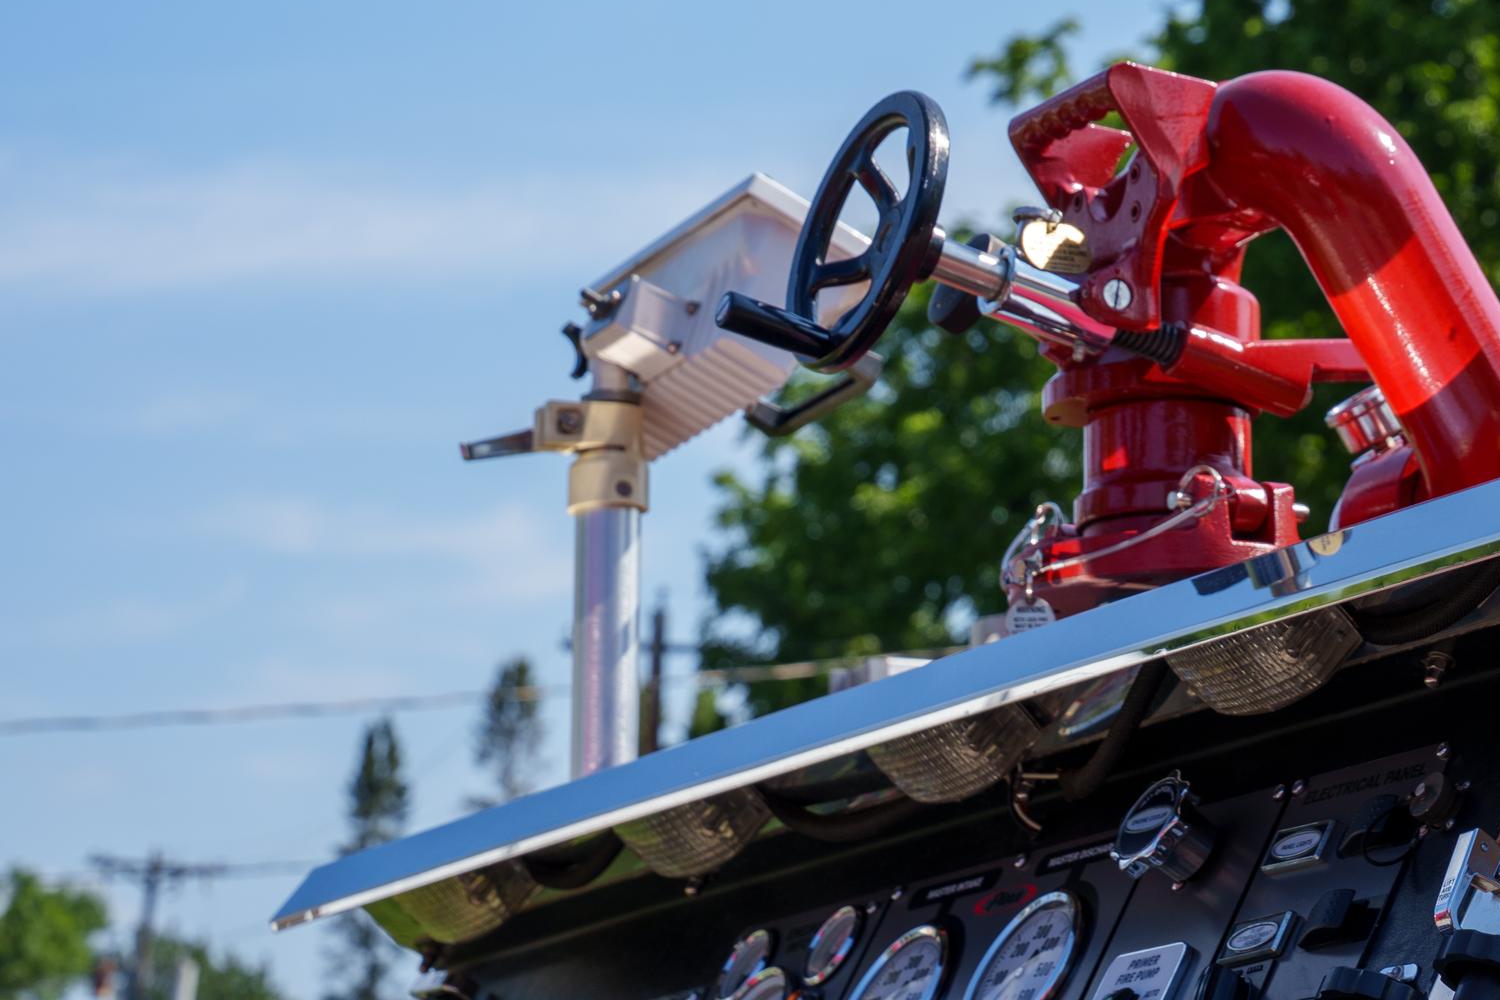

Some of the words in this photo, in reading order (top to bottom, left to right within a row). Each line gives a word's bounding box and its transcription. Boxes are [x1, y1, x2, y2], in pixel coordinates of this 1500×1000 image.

[1303, 773, 1381, 805] ELECTRICAL
[1383, 762, 1426, 784] PANEL
[1032, 924, 1053, 940] 300
[1033, 961, 1054, 977] 500
[1128, 954, 1161, 969] PRIMER
[1115, 969, 1136, 985] FIRE
[1135, 967, 1160, 982] PUMP
